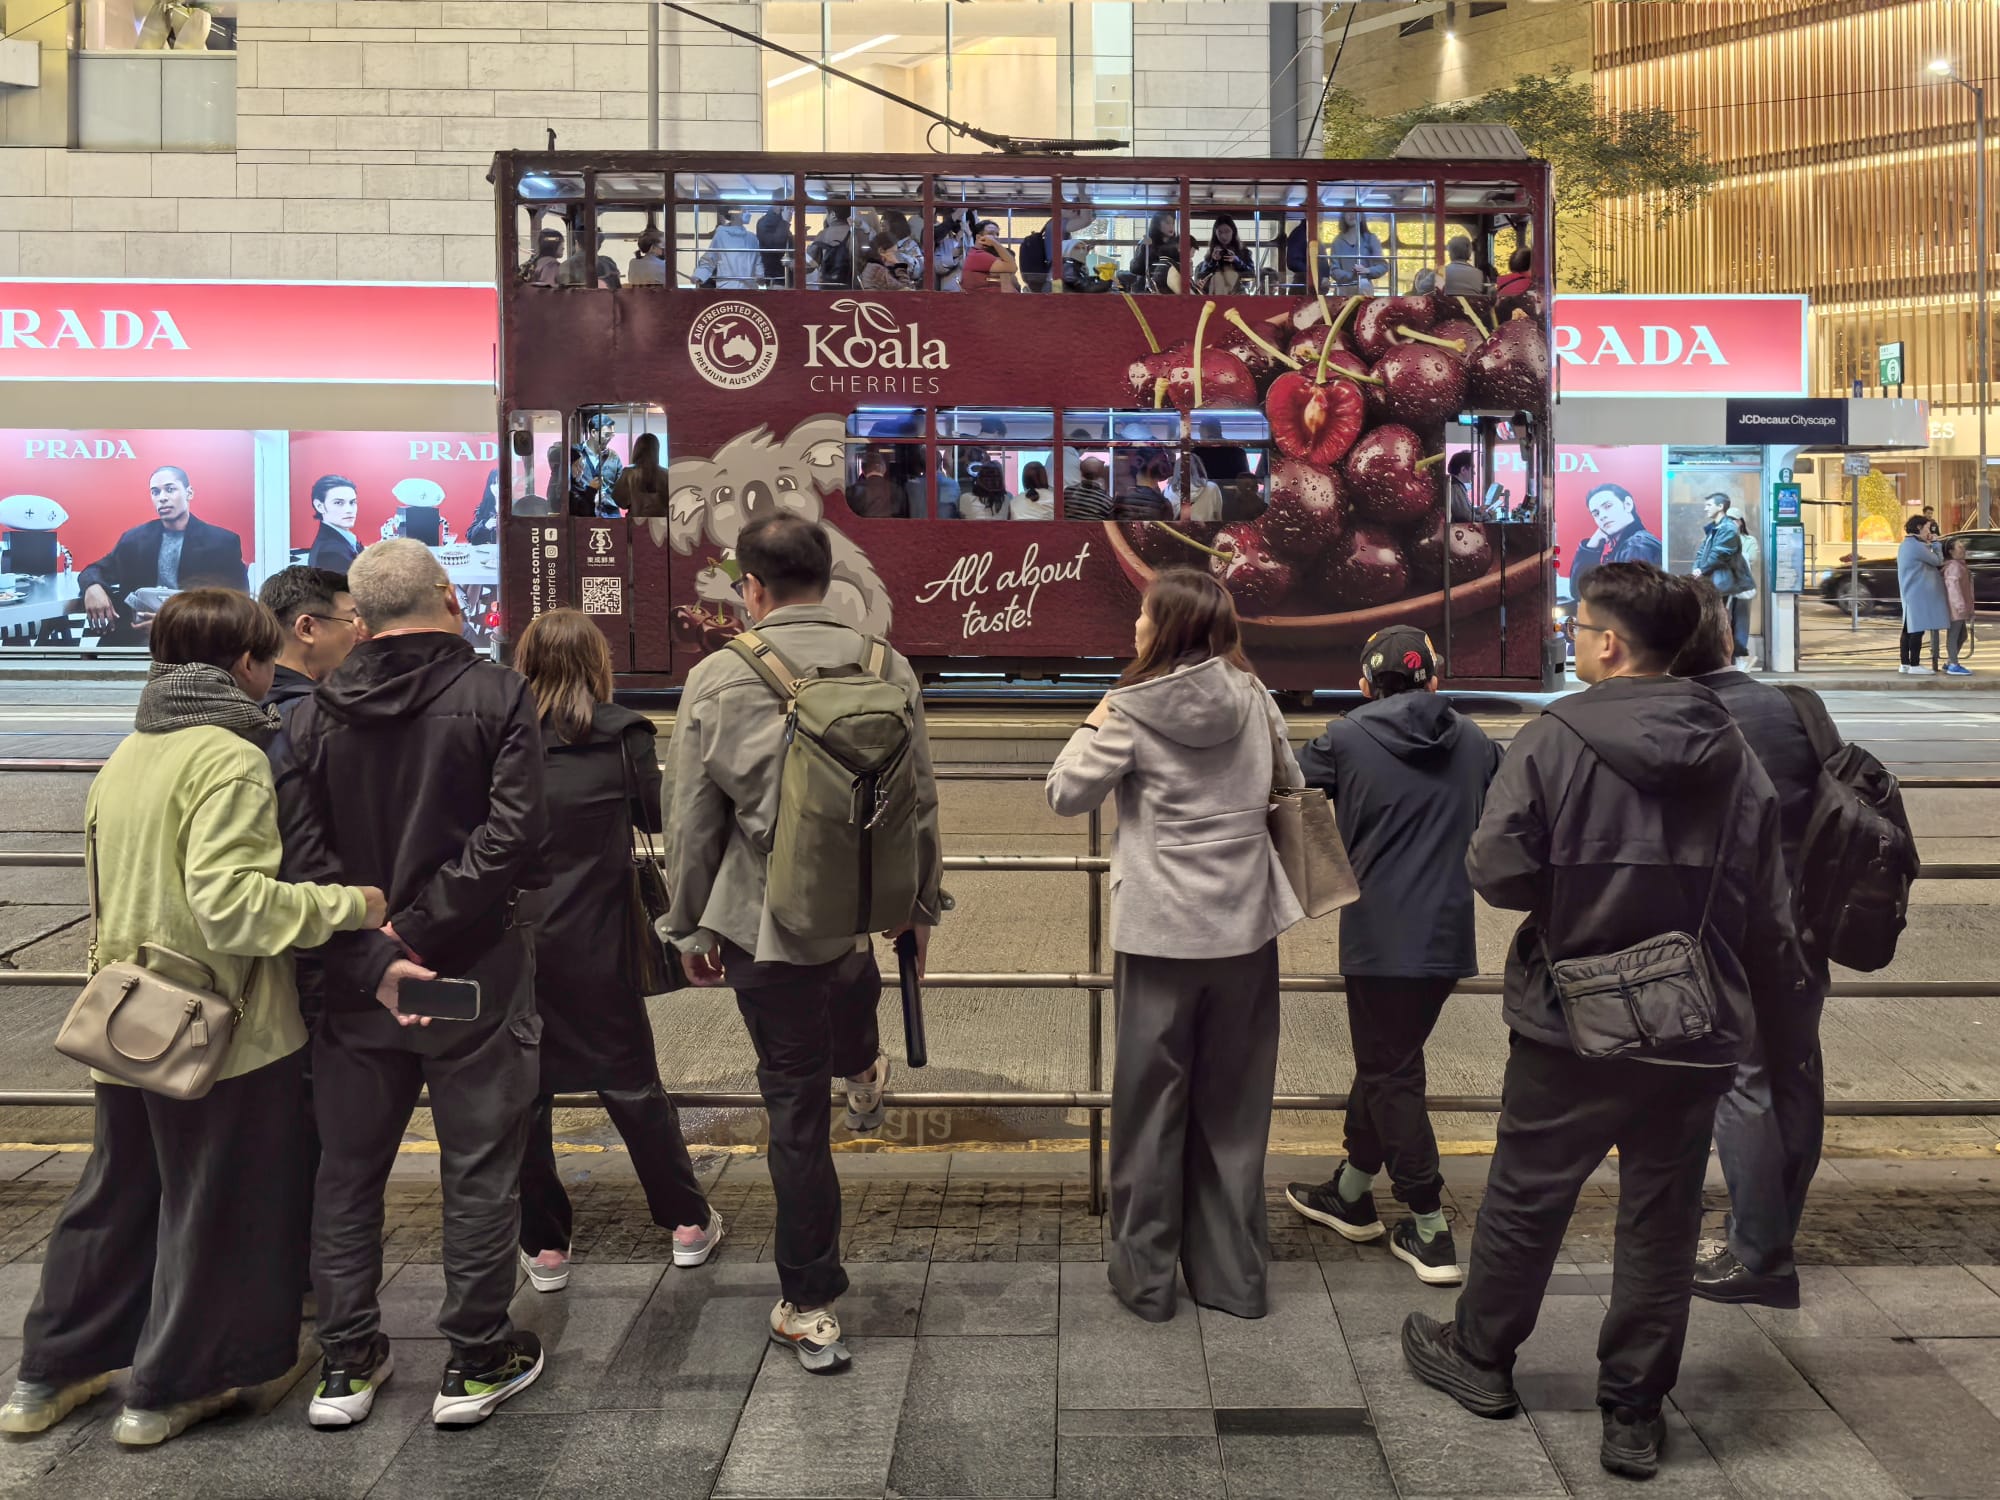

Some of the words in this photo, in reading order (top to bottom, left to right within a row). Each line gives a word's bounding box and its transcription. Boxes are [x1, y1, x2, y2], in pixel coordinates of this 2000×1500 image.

[0, 308, 192, 350] RADA
[693, 323, 705, 340] AIR
[702, 305, 752, 325] FREIGHTED
[751, 312, 773, 340] FRESH
[802, 322, 951, 370] Koala
[1552, 325, 1730, 366] RADA
[694, 351, 727, 385] PREMIUM
[729, 351, 773, 385] AUSTRALIAN
[810, 375, 940, 394] CHERRIES
[1738, 414, 1790, 425] JCDecaux
[1790, 414, 1836, 426] Cityscape
[25, 439, 137, 460] PRADA
[408, 440, 499, 462] PRAD
[546, 562, 557, 613] cherries
[915, 551, 993, 603] All
[996, 542, 1090, 591] about
[962, 583, 1040, 639] taste!
